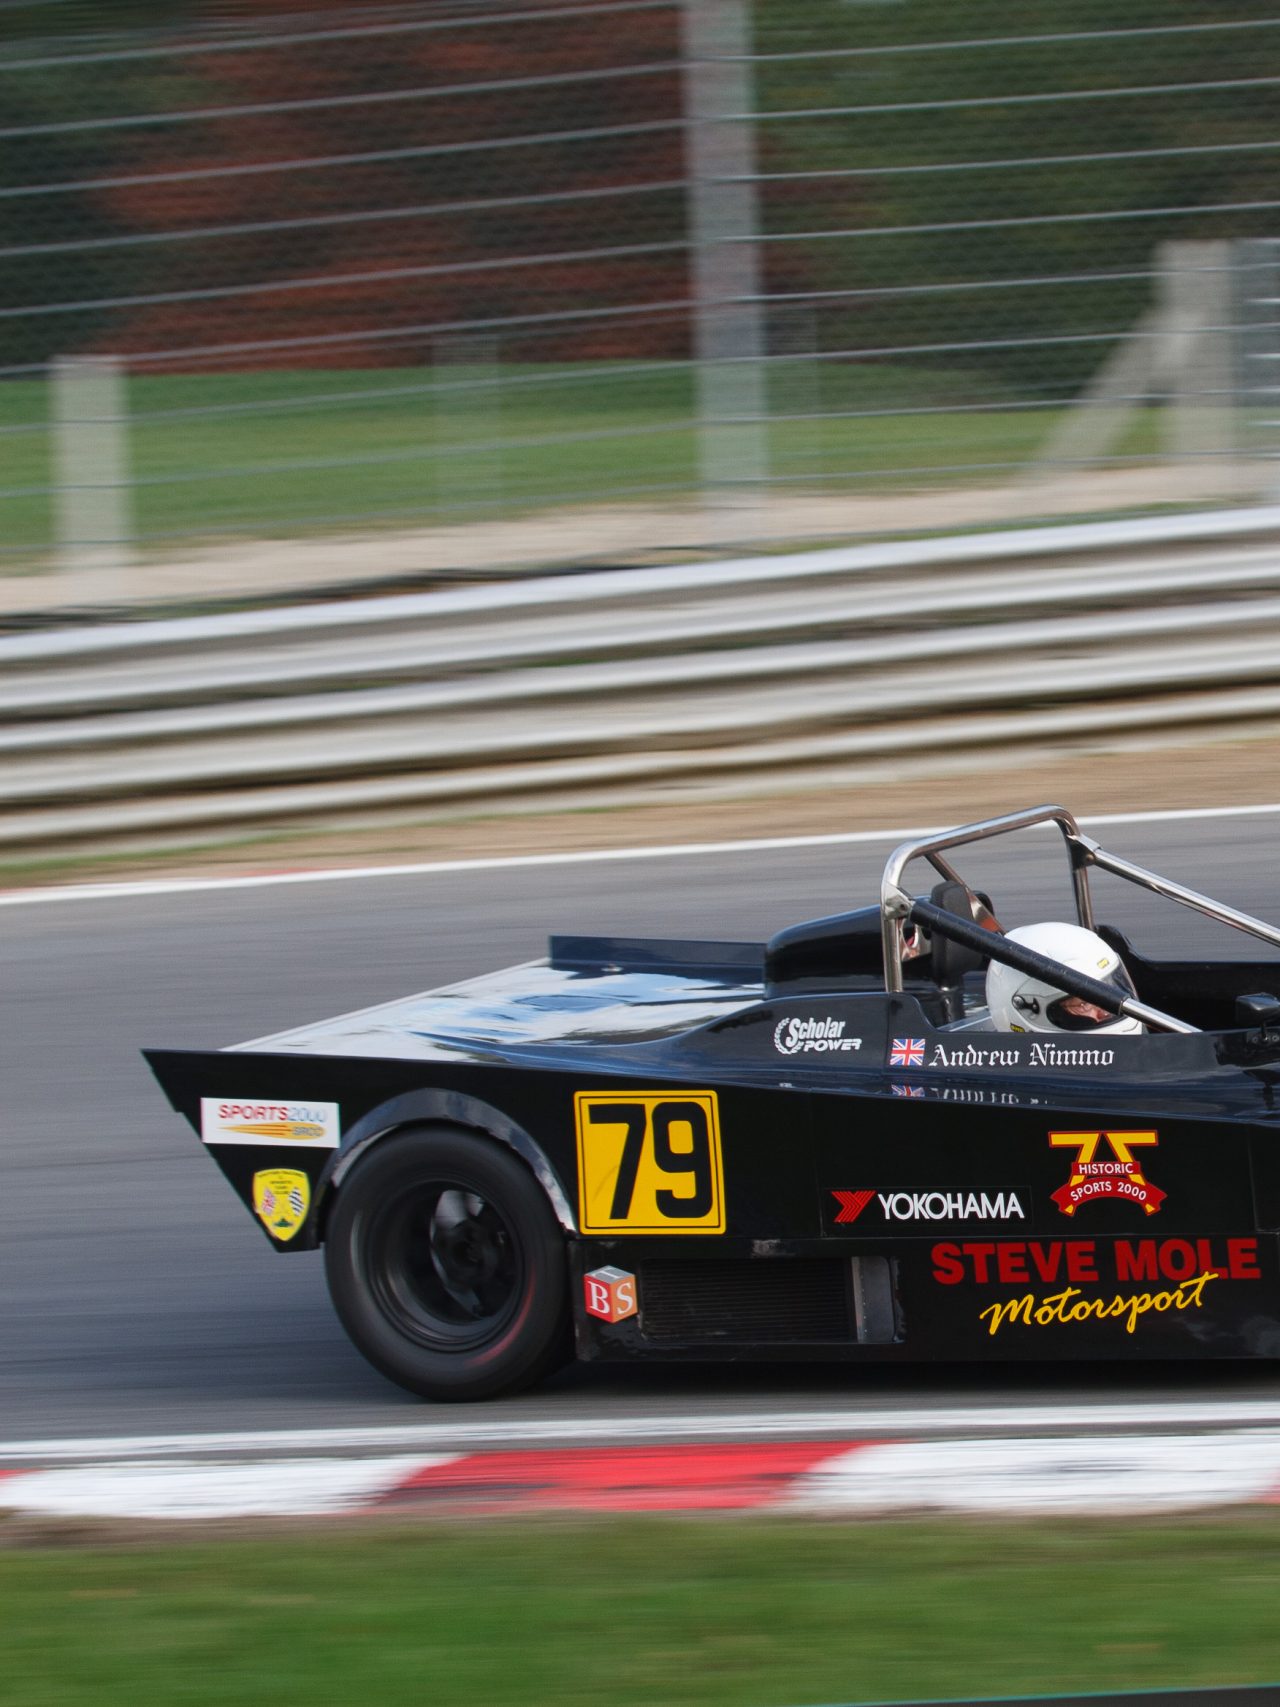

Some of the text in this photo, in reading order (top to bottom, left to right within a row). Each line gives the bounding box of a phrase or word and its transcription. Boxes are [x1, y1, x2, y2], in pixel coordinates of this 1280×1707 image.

[785, 1017, 846, 1047] Scholar
[803, 1038, 862, 1052] POWER
[928, 1043, 1114, 1067] Andrew Nimmo
[588, 1101, 713, 1219] 79
[1078, 1163, 1134, 1175] HISTORIC
[1070, 1181, 1147, 1202] SPORTS 2000
[878, 1192, 1025, 1220] YOKOHAMA
[931, 1237, 1262, 1285] STEVE MOLE
[979, 1271, 1218, 1335] Motorsport
